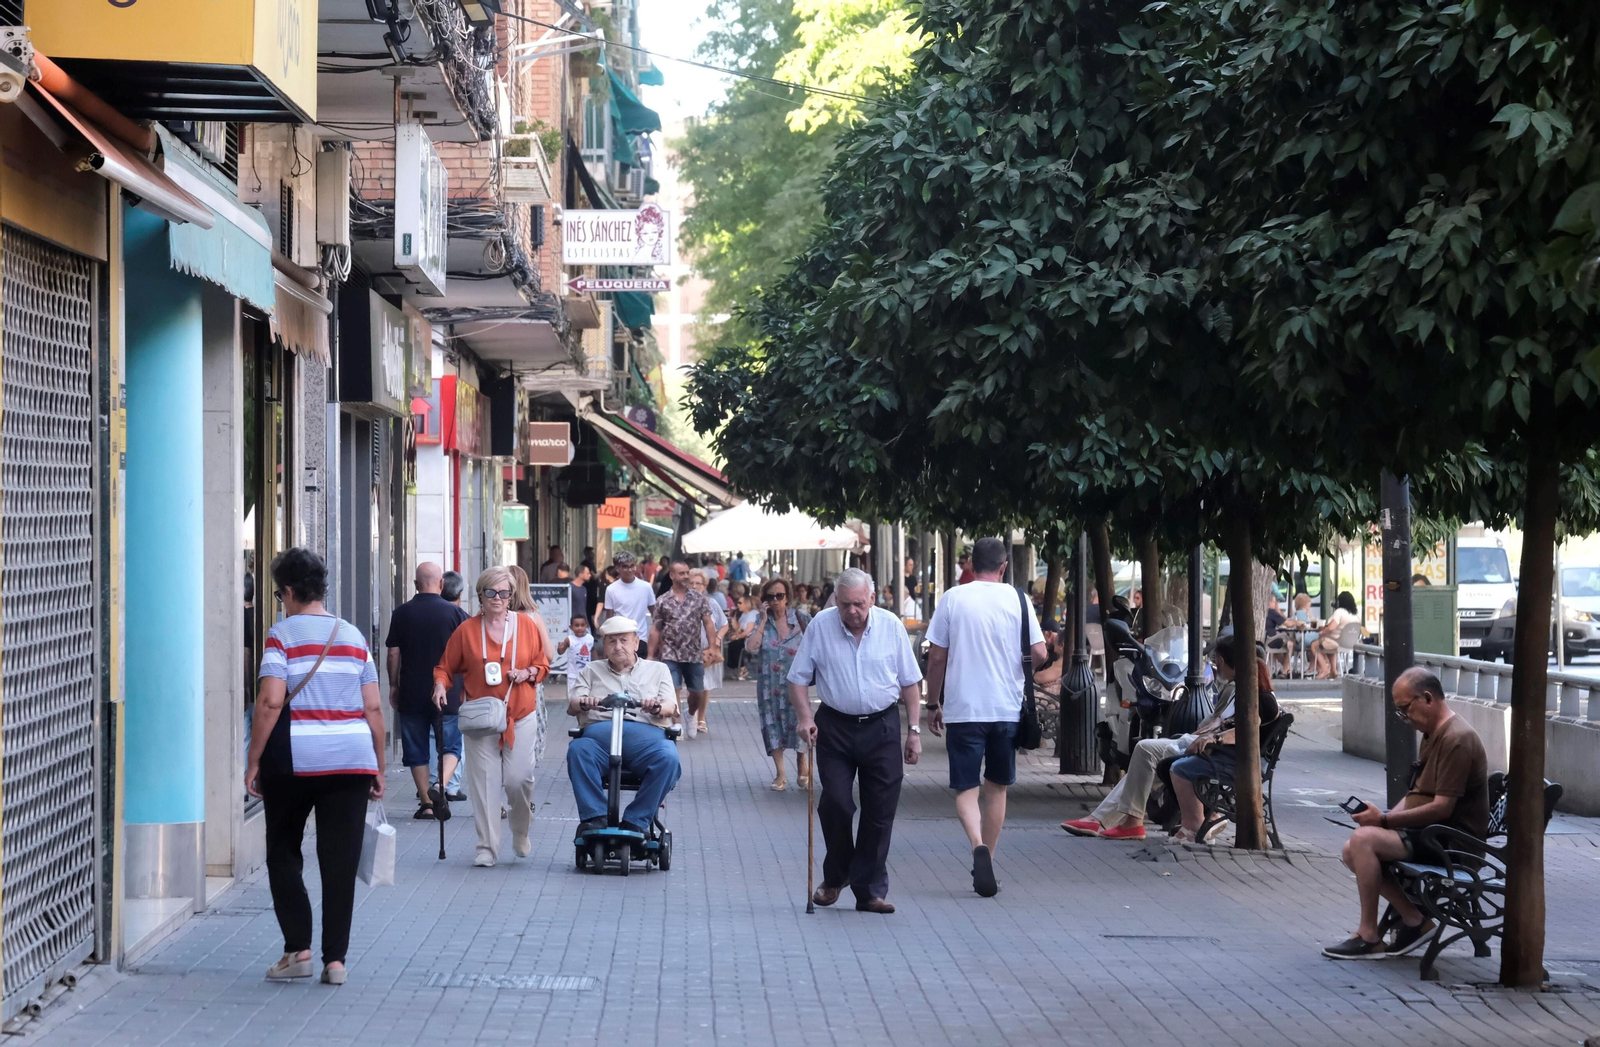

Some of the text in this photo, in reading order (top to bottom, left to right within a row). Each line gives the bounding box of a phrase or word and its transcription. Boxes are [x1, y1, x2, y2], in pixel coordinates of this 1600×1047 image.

[566, 215, 632, 243] INÉS SÁNCHEZ
[567, 248, 630, 258] ESTILISTAS
[576, 280, 667, 289] PELUQUERIA
[530, 438, 567, 447] marco
